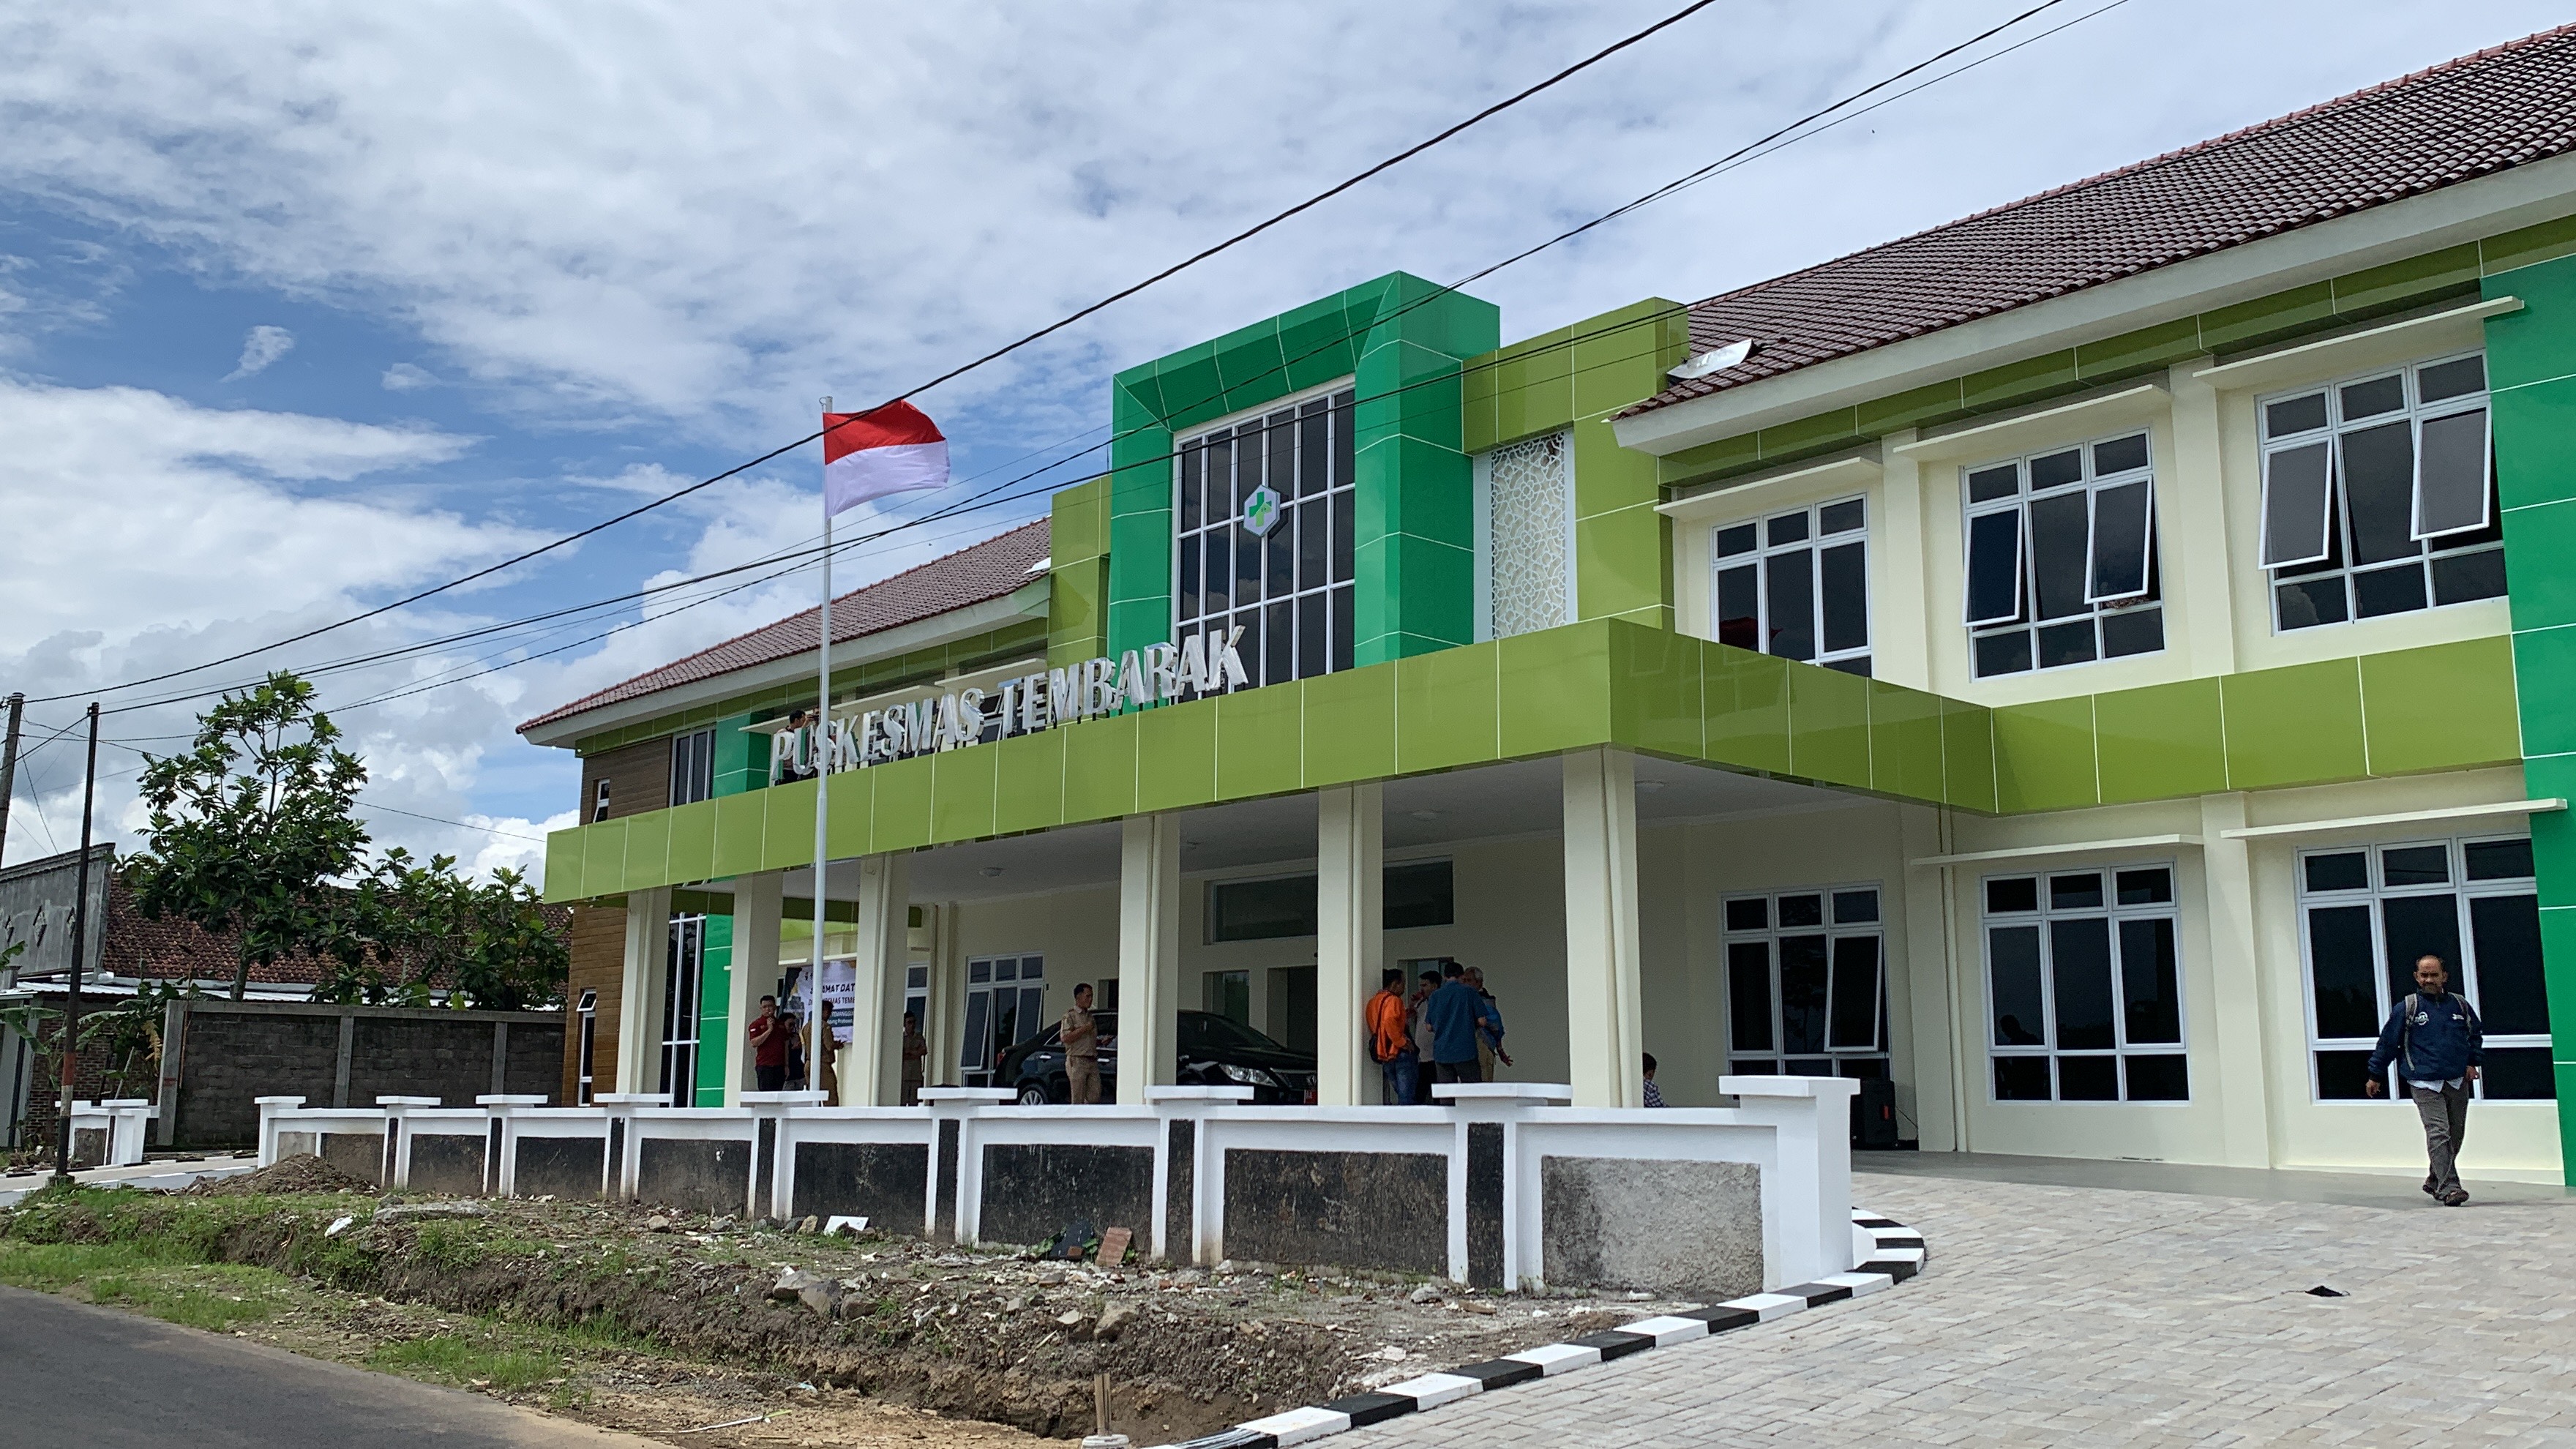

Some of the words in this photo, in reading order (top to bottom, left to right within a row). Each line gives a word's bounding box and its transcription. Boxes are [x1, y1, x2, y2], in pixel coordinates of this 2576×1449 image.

[771, 687, 985, 781] PUSKESMAS
[997, 624, 1249, 734] TEMBARAK
[840, 982, 855, 992] DAT
